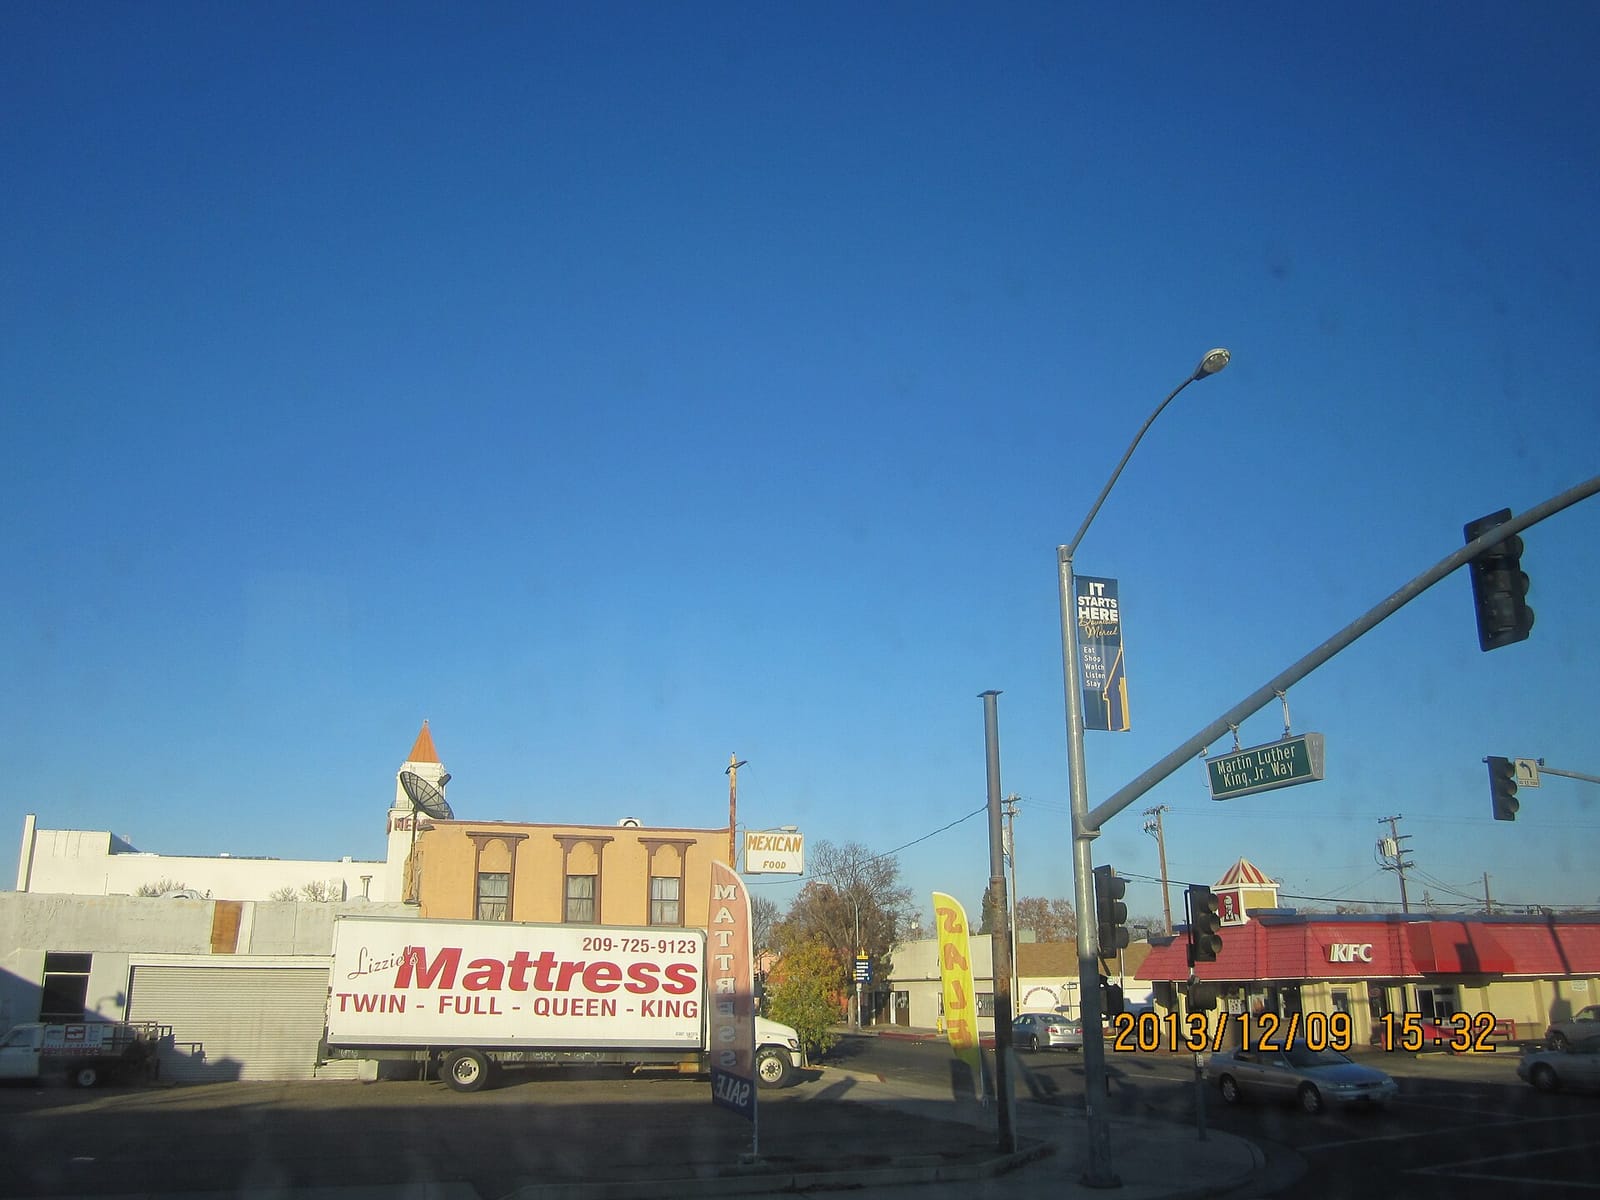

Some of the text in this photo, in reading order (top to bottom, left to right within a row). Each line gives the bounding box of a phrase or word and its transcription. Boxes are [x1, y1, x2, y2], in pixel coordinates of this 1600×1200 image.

[1089, 582, 1105, 597] IT
[1078, 596, 1117, 609] STARTS
[1078, 606, 1119, 623] HERE
[1083, 646, 1096, 654] Eat
[1083, 655, 1102, 663] Shop
[1084, 663, 1105, 671] Watch
[1085, 671, 1106, 679] Listen
[1086, 680, 1102, 689] Stay
[1217, 745, 1295, 776] Martin Luther
[1223, 761, 1294, 788] King, Jr. Way
[748, 835, 802, 852] MEXICAN
[763, 860, 786, 869] FOOD
[582, 936, 697, 954] 209-725-9123
[1329, 943, 1373, 962] KFC
[347, 945, 419, 980] Lizzie's
[393, 946, 698, 995] Mattress
[336, 993, 406, 1014] TWIN
[439, 995, 502, 1015] FULL
[533, 997, 616, 1017] QUEEN
[641, 1000, 698, 1018] KING
